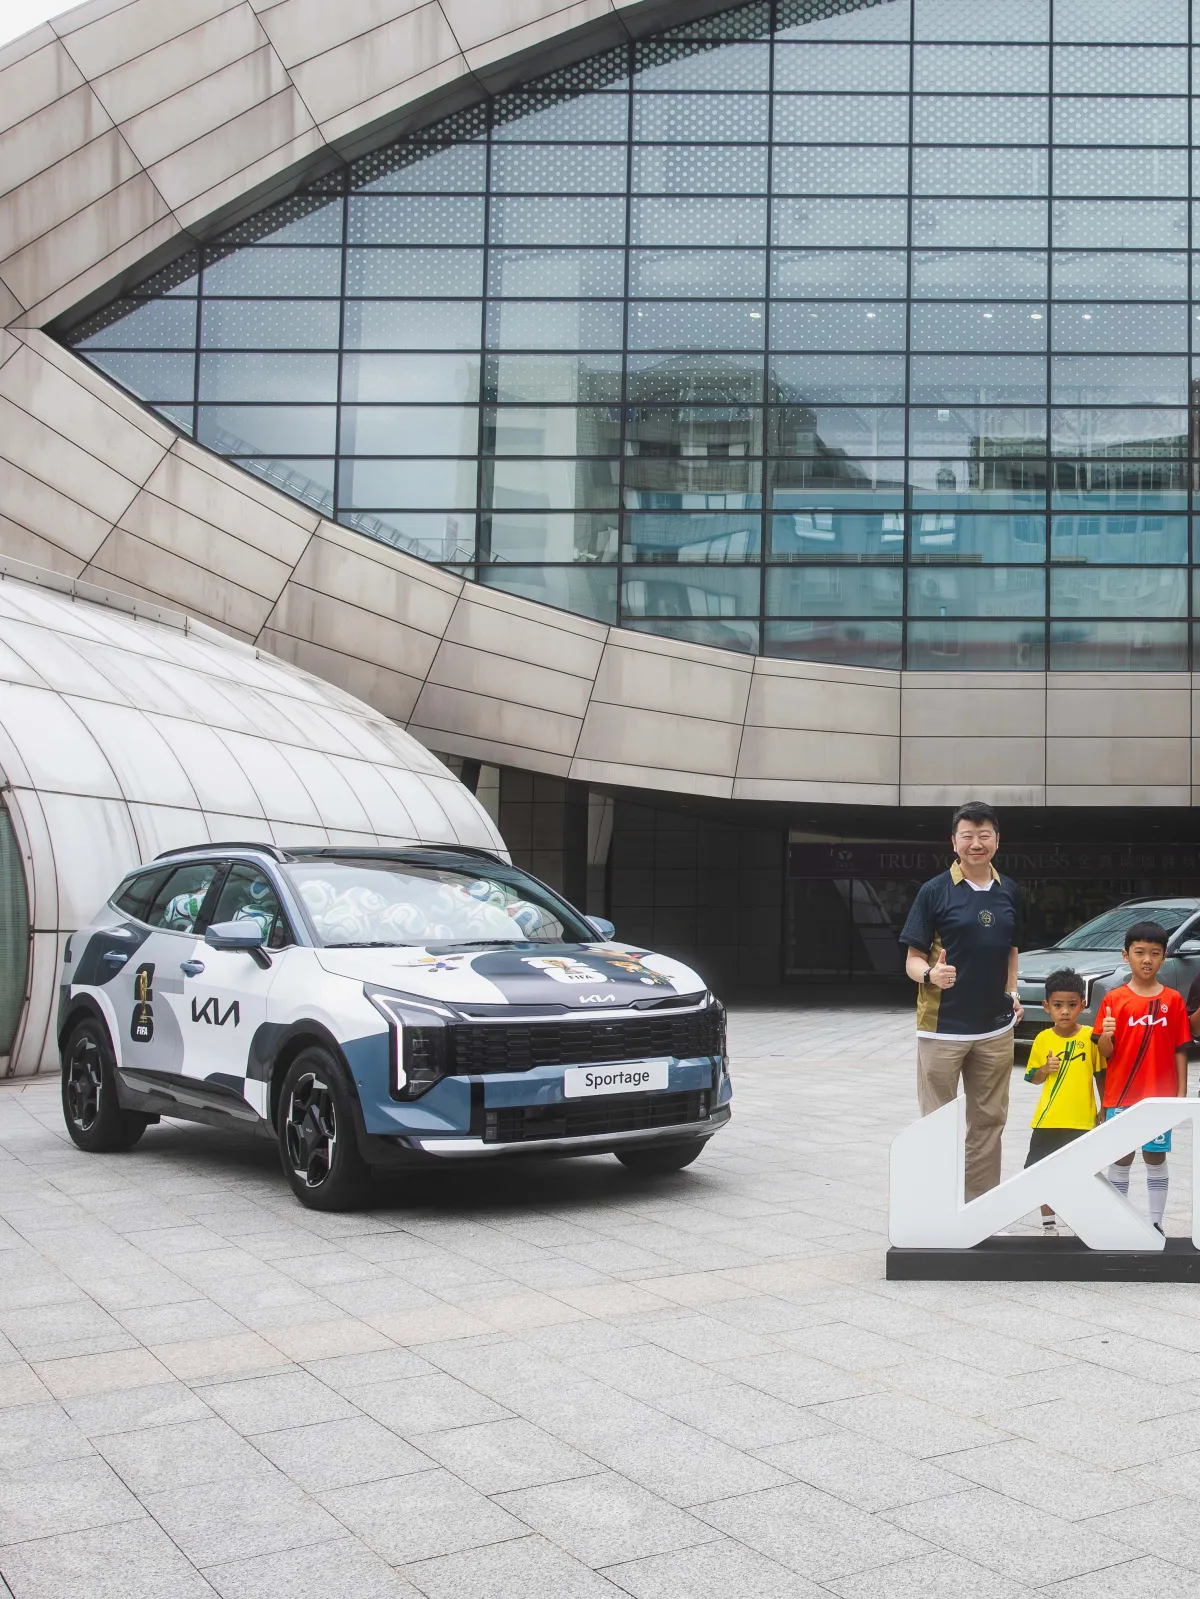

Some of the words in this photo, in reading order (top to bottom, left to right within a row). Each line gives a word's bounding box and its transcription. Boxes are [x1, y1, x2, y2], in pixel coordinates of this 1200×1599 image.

[876, 853, 926, 869] TRUE
[579, 994, 616, 1004] KIA
[191, 995, 240, 1028] KIA
[1128, 1014, 1168, 1027] KIA
[136, 1025, 148, 1036] FIFA
[585, 1071, 650, 1090] Sportage
